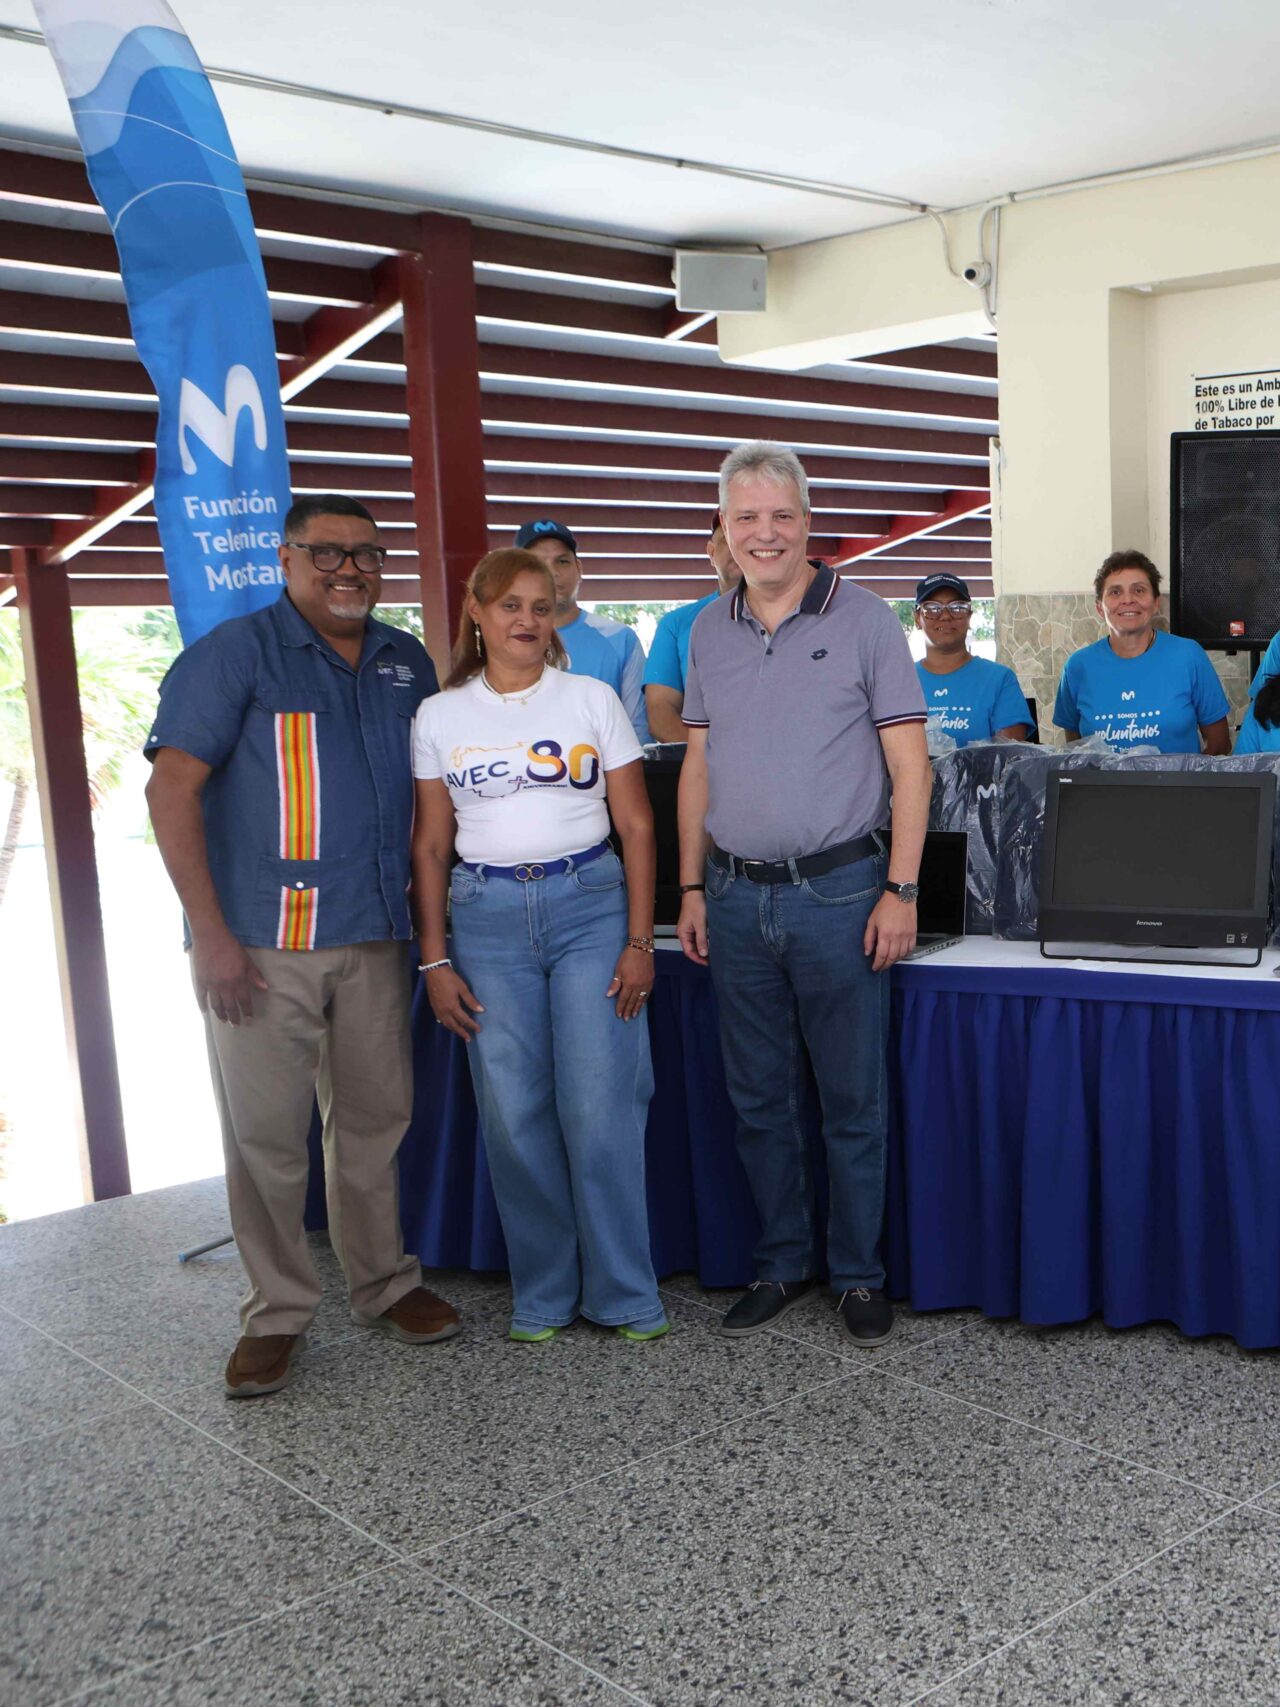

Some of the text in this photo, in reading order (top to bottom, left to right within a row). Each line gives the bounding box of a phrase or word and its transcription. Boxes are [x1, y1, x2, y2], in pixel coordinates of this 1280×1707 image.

[1195, 385, 1219, 397] Este
[1222, 384, 1235, 394] es
[1238, 383, 1252, 393] un
[1195, 400, 1225, 413] 100%
[1228, 398, 1257, 411] Libre
[1260, 396, 1274, 408] de
[1195, 415, 1275, 430] de Tabaco por
[940, 710, 970, 730] tarios
[1095, 718, 1160, 742] voluntarios
[447, 761, 510, 789] AVEC
[526, 740, 599, 790] 80
